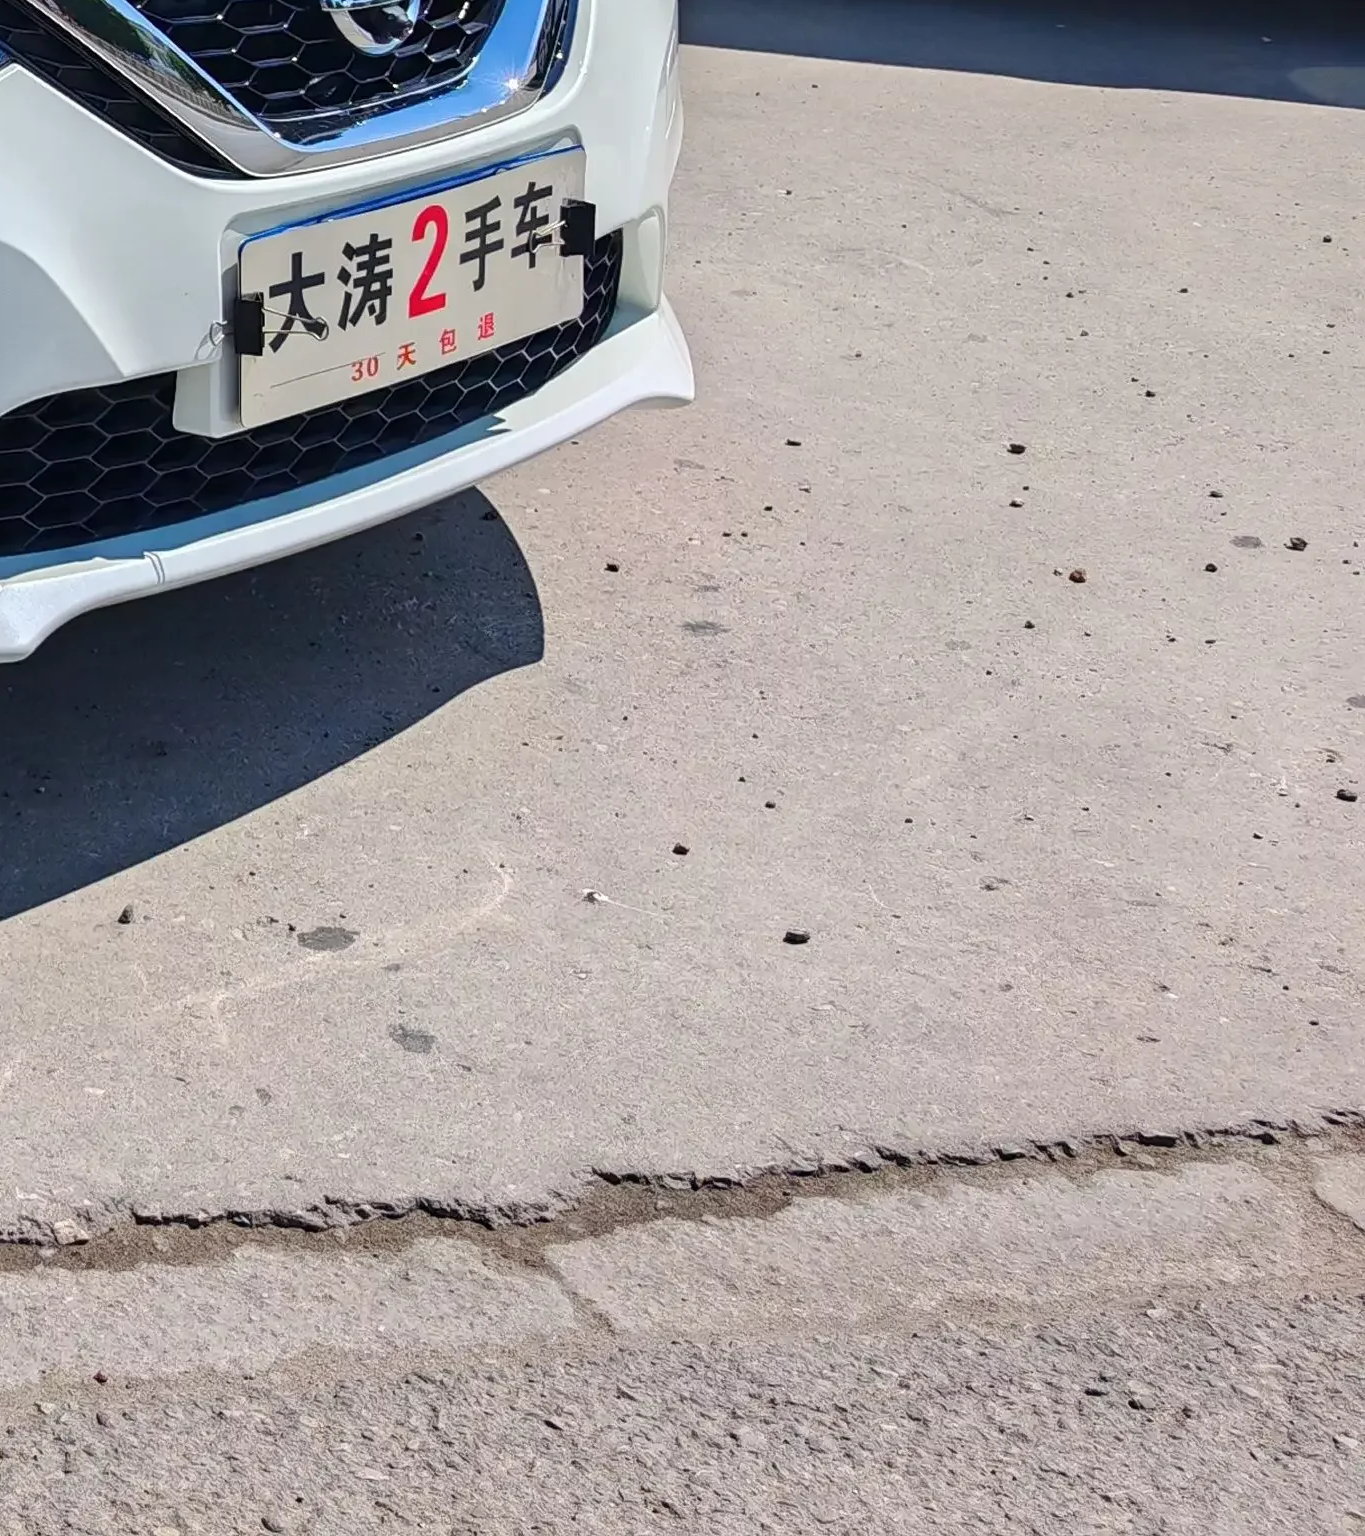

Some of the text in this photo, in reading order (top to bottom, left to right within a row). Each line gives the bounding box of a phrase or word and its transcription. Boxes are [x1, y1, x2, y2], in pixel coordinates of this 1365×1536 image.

[268, 180, 556, 354] 大涛2手车
[351, 312, 495, 382] 30天包退
